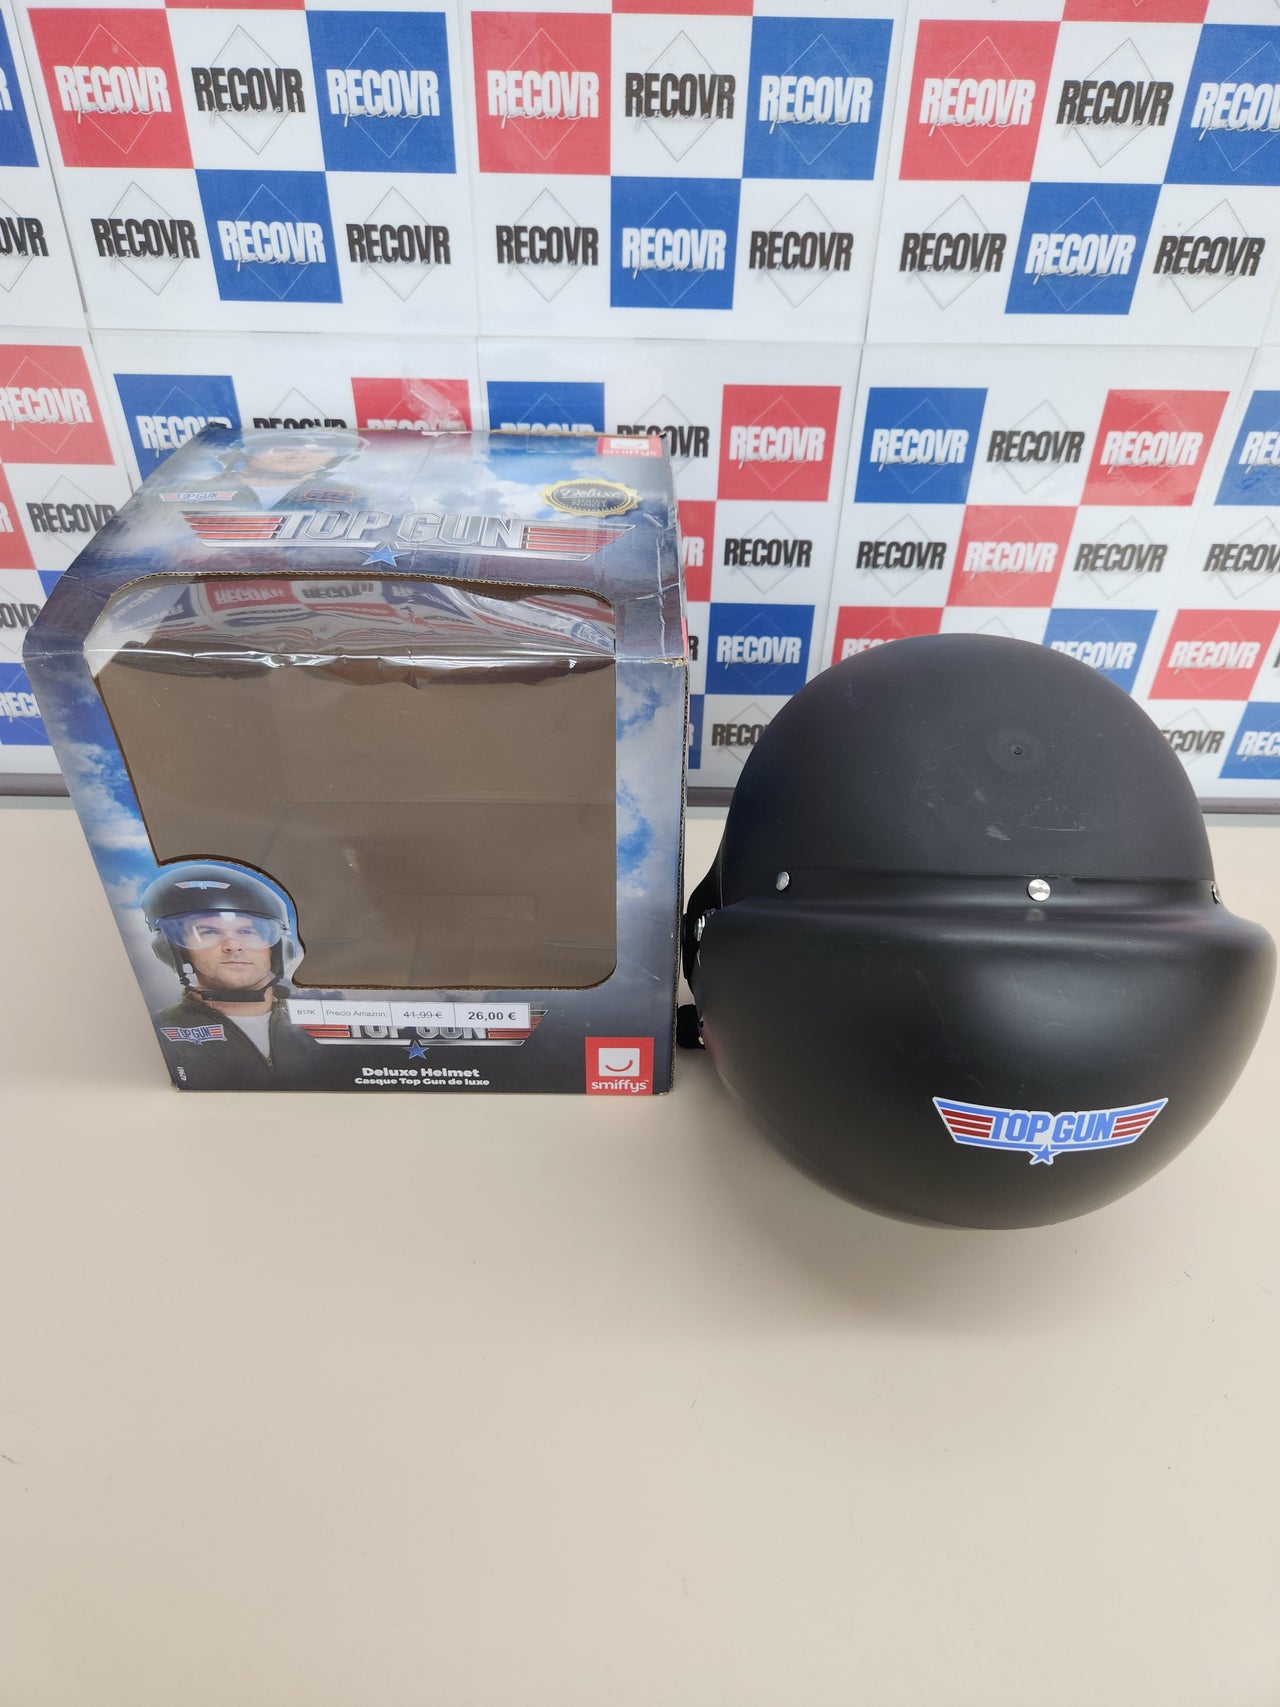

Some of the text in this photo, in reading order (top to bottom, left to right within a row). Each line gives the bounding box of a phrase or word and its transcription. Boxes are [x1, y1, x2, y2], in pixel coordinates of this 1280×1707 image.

[54, 66, 172, 112] RECOVR
[191, 67, 306, 113] RECOVR
[326, 69, 440, 116] RECOVR
[487, 70, 600, 118] RECOVR
[625, 73, 736, 119] RECOVR
[759, 75, 873, 123] RECOVR
[919, 78, 1036, 125] RECOVR
[1056, 80, 1174, 126] RECOVR
[1188, 83, 1280, 129] RECOV
[90, 218, 200, 258] RECOVR
[217, 220, 326, 263] RECOVR
[346, 224, 451, 265] RECOVR
[496, 225, 599, 266] RECOVR
[622, 228, 727, 270] RECOVR
[749, 231, 854, 271] RECOVR
[899, 232, 1007, 273] RECOVR
[1024, 233, 1136, 275] RECOVR
[1153, 235, 1266, 276] RECOVR
[729, 426, 826, 461] RECOVR
[869, 429, 969, 464] RECOVR
[986, 431, 1085, 463] RECOVR
[1100, 431, 1203, 466] RECOVR
[1238, 431, 1280, 466] REC
[276, 510, 526, 549] TOP GUN
[724, 538, 813, 567] RECOVR
[856, 541, 947, 570] RECOVR
[962, 541, 1058, 573] RECOVR
[1073, 543, 1168, 572] RECOVR
[1203, 543, 1280, 573] RECOV
[716, 635, 802, 664] RECOVR
[1168, 641, 1261, 669] RECOVR
[326, 1009, 352, 1017] Precio
[403, 1011, 444, 1019] 41,99 €
[468, 1011, 517, 1021] 26,00 €
[354, 1077, 490, 1086] Casque Top Gun de luxe
[362, 1067, 480, 1078] Deluxe Helmet
[591, 1079, 647, 1093] smiffys
[990, 1112, 1112, 1143] TOP GUN
